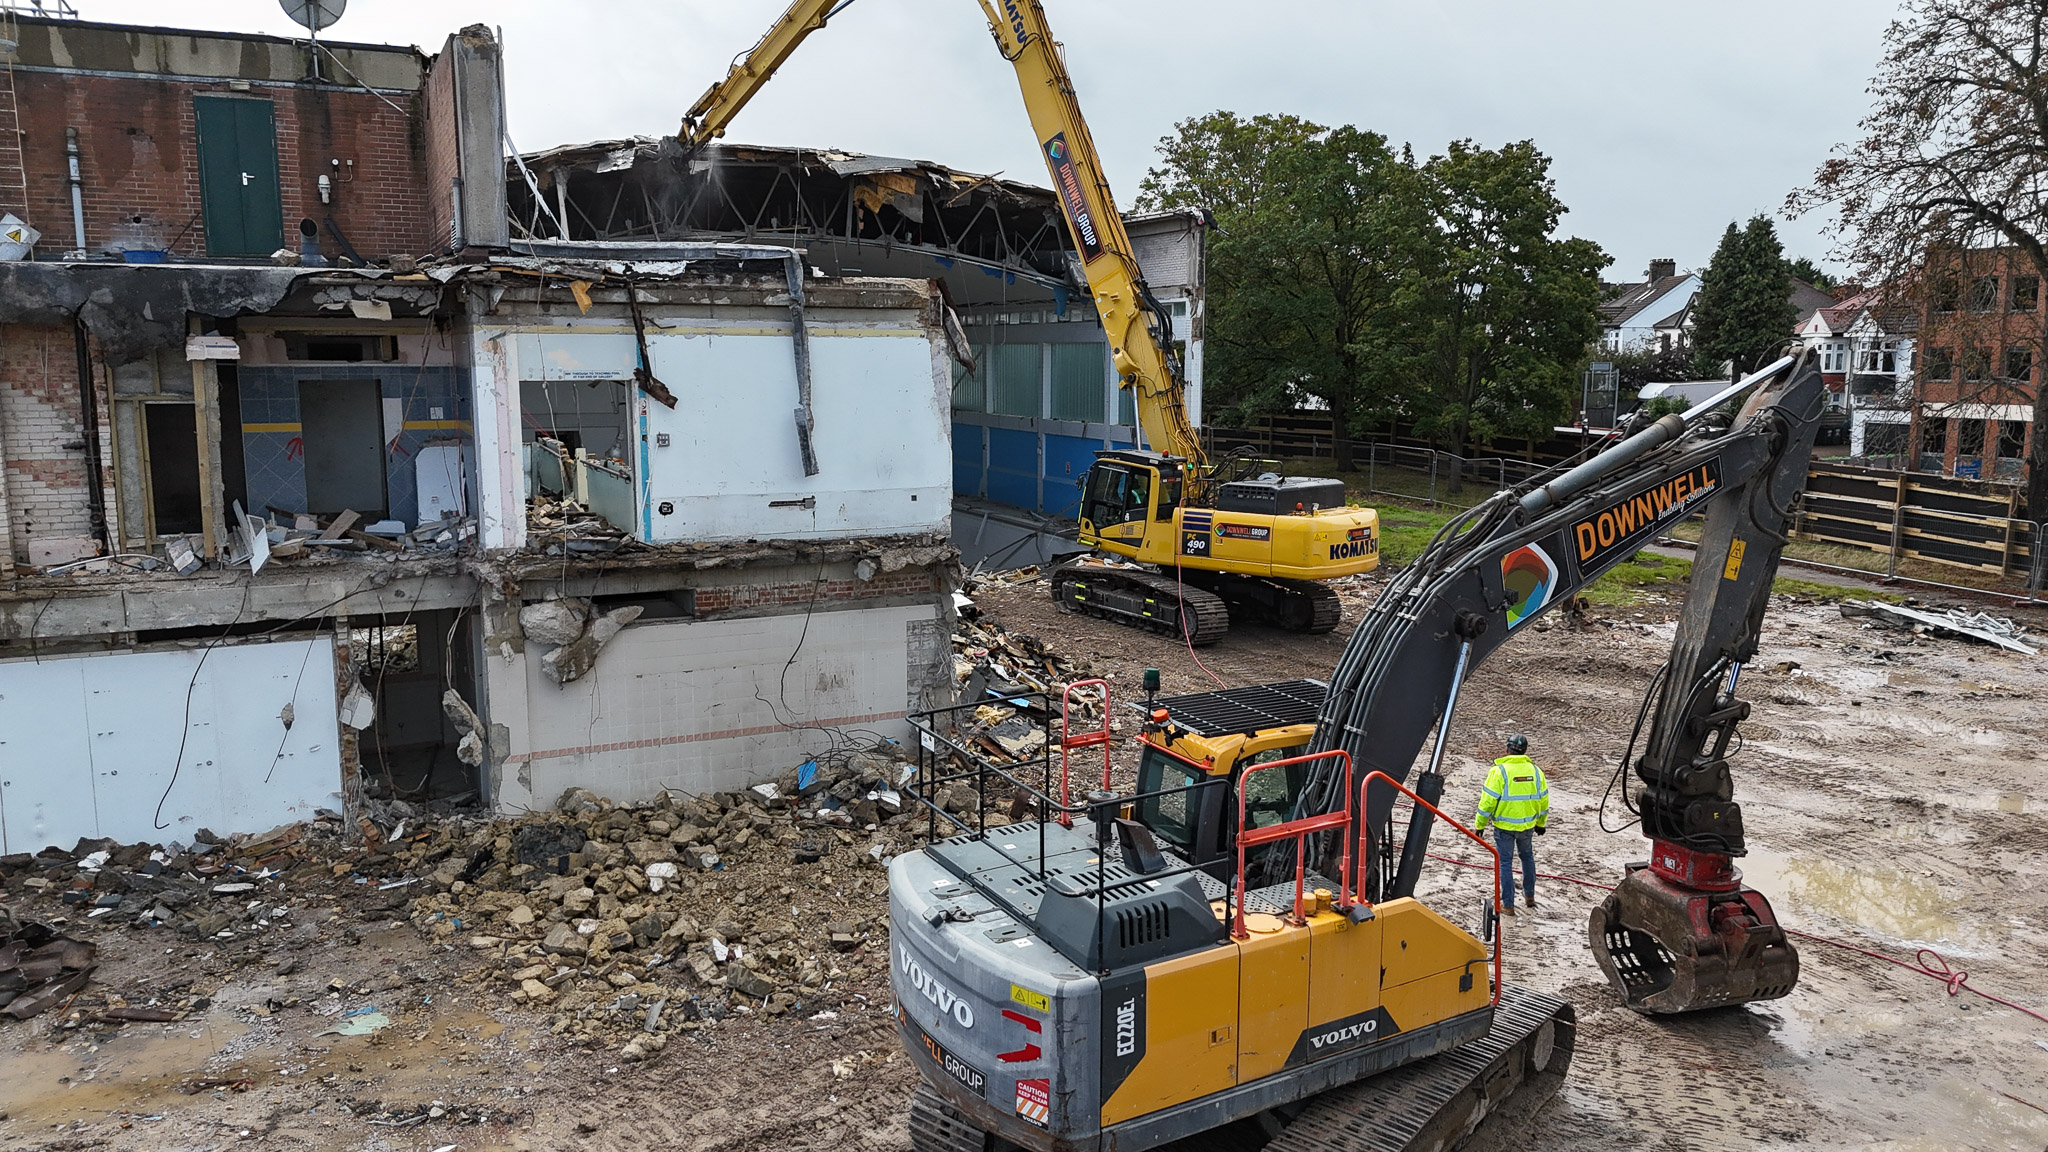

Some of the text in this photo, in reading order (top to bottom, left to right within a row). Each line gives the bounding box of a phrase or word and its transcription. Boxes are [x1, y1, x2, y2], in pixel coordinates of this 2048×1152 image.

[1060, 162, 1085, 217] DOWNWELL
[1078, 213, 1097, 246] GROUP
[1576, 466, 1716, 561] DOWNWELL
[1658, 483, 1716, 521] Enabling Solutions
[1187, 540, 1206, 549] 490
[1251, 528, 1268, 536] GROUP
[899, 943, 974, 1029] VOLVO
[1310, 1020, 1377, 1048] VOLVO
[945, 1054, 983, 1089] GROUP
[1018, 1082, 1048, 1099] CAUTION
[1018, 1089, 1048, 1105] KEEP CLEAR
[1022, 1115, 1042, 1127] VOLVO
